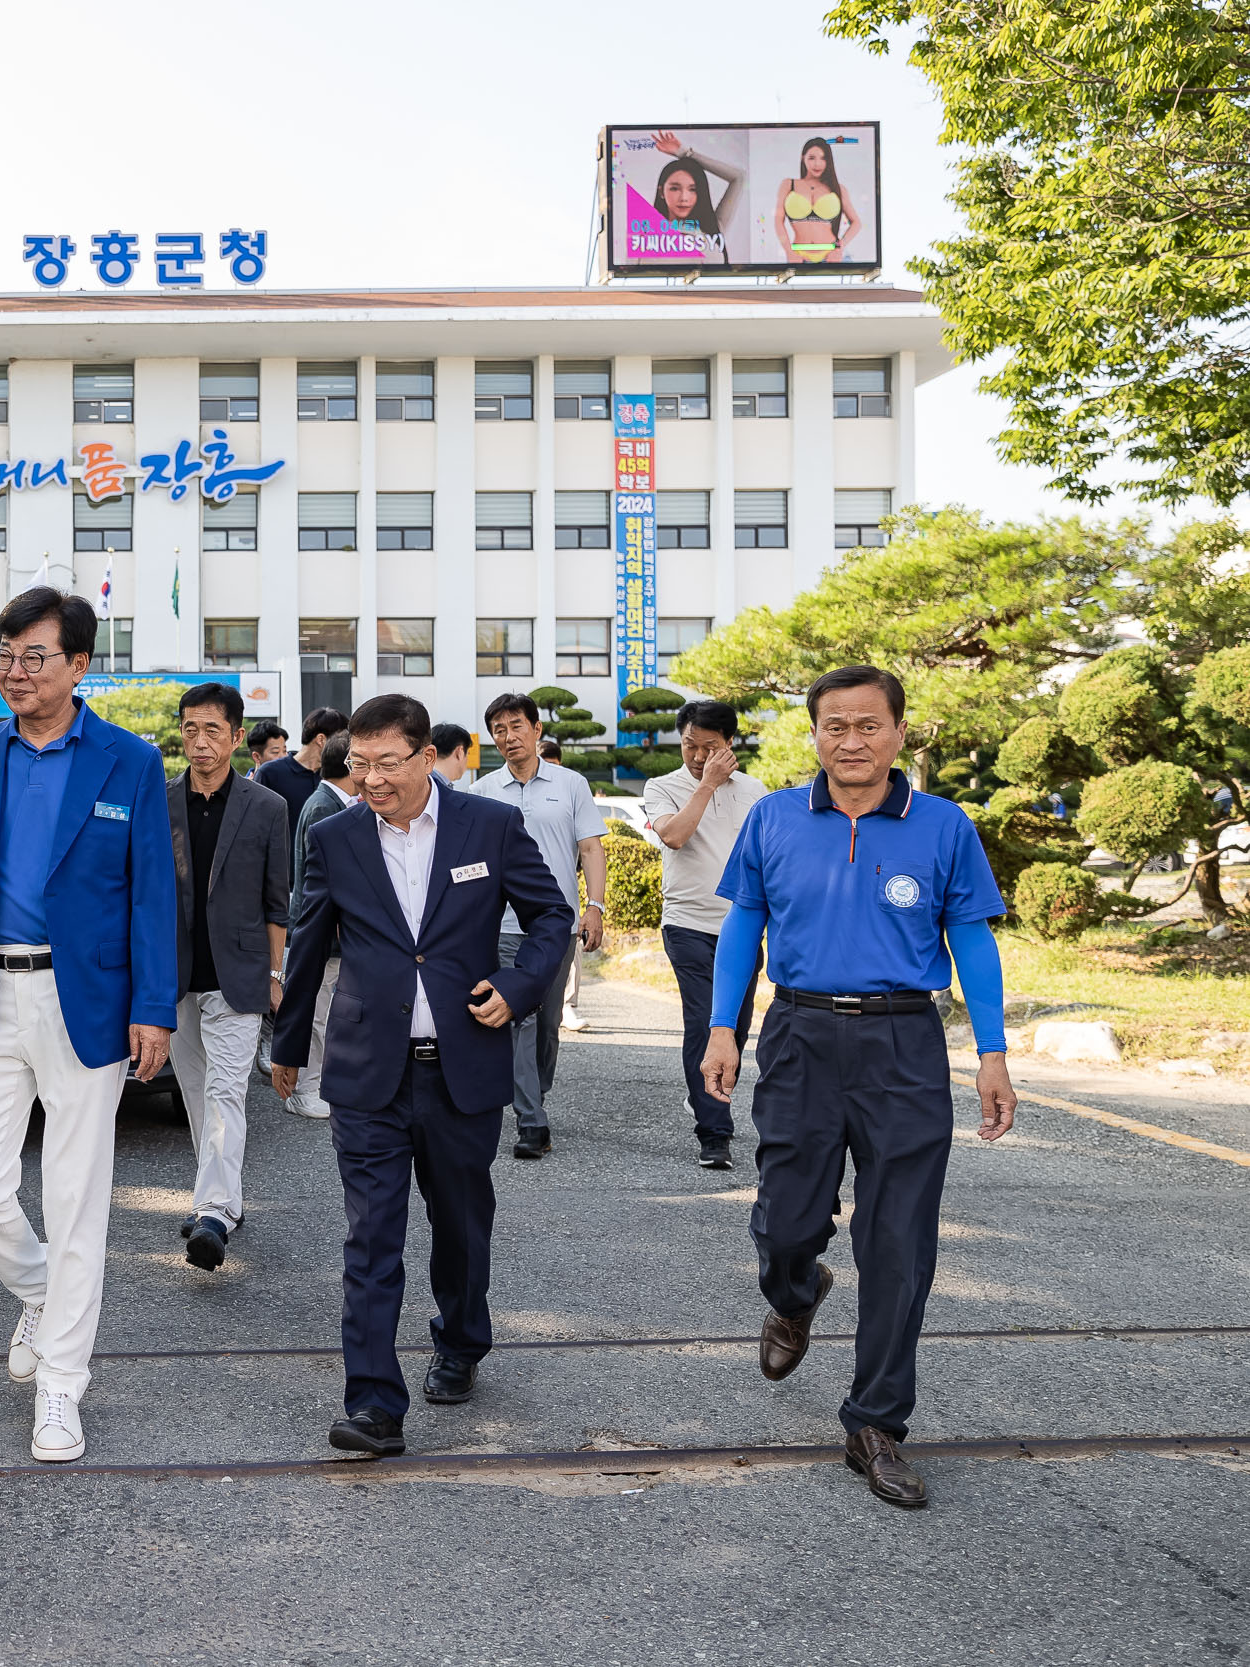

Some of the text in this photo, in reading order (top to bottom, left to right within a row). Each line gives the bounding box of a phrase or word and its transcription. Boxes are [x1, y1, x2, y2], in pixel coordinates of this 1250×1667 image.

[23, 229, 267, 288] 장흥군청
[618, 403, 650, 424] 경축
[618, 441, 650, 457] 국비
[80, 442, 126, 500] 품
[140, 429, 285, 500] 장흥
[617, 457, 650, 474] 45억
[618, 473, 650, 490] 확보
[617, 496, 653, 514] 2024
